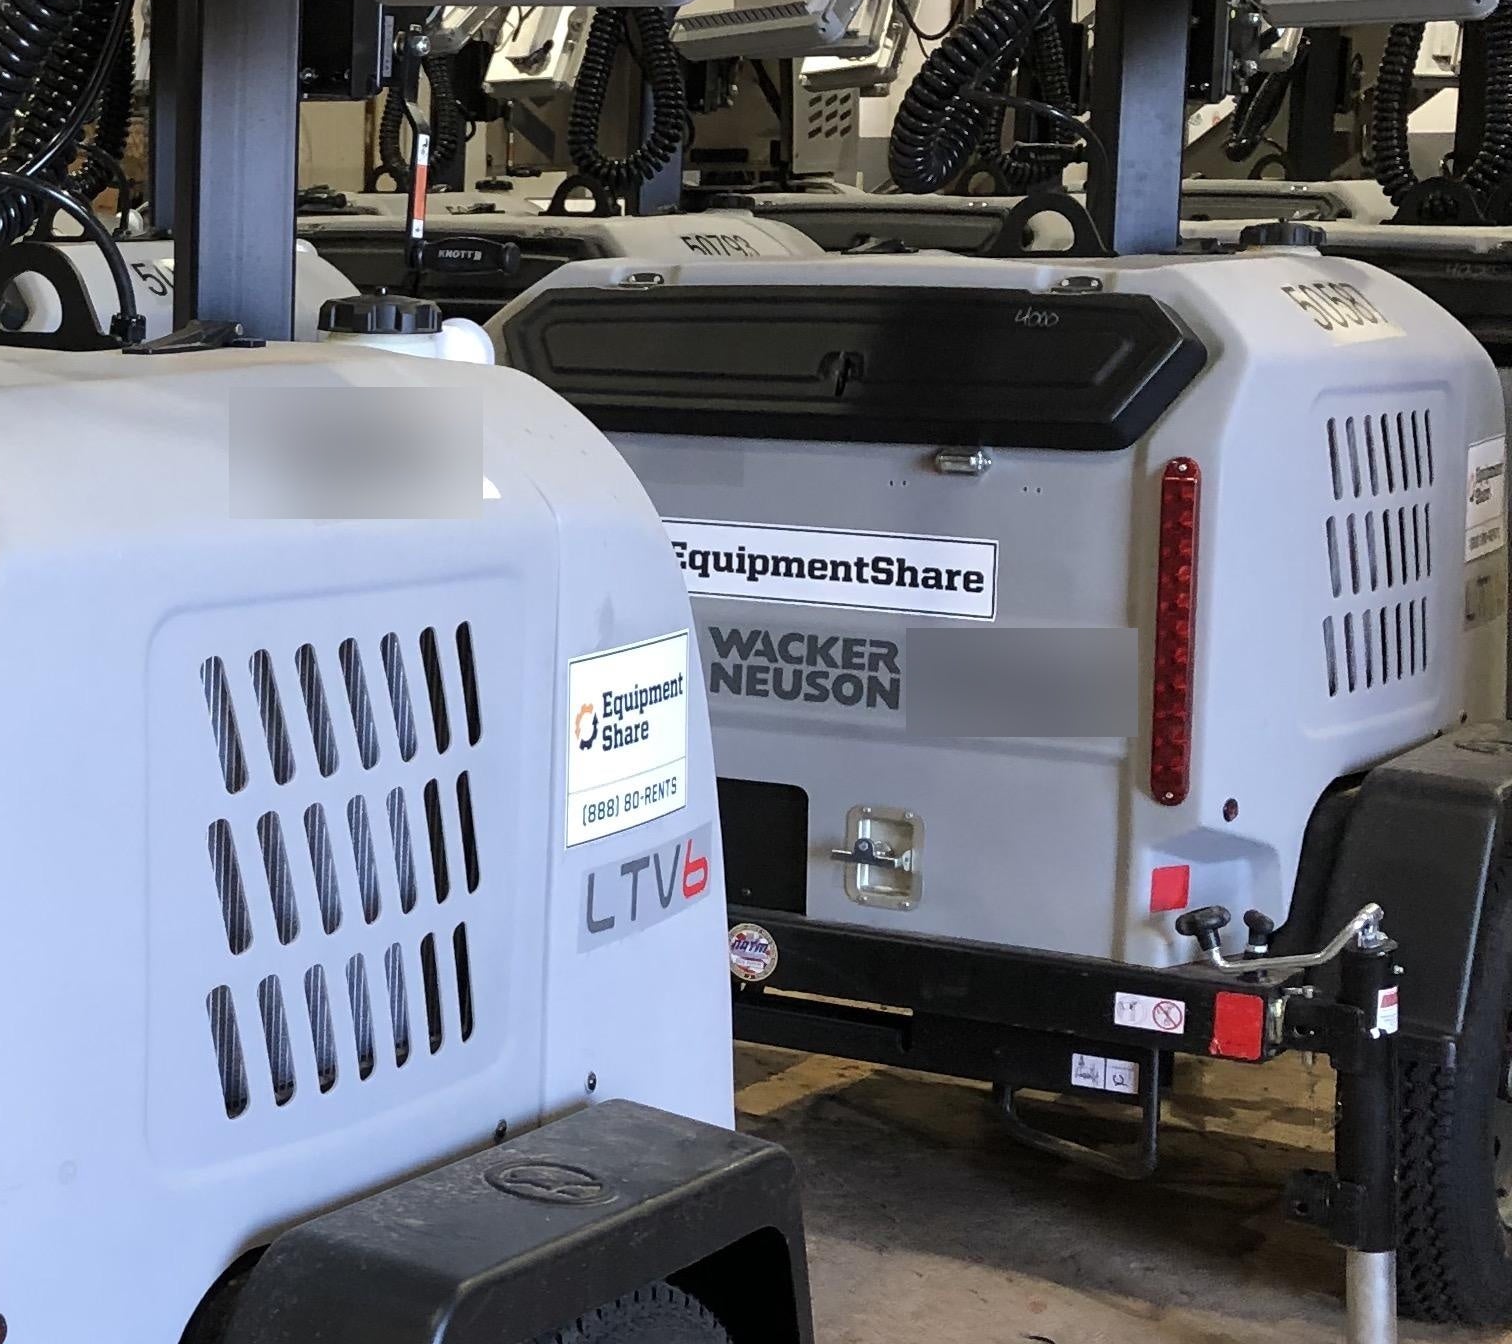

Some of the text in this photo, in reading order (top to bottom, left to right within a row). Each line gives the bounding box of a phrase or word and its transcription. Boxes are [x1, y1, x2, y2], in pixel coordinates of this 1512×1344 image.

[437, 249, 474, 259] KNOTT
[708, 626, 901, 675] WACKER
[601, 671, 684, 722] Equipment
[709, 661, 901, 710] NEUSON
[601, 719, 650, 752] Share
[581, 775, 678, 826] (888) 80-RENTS
